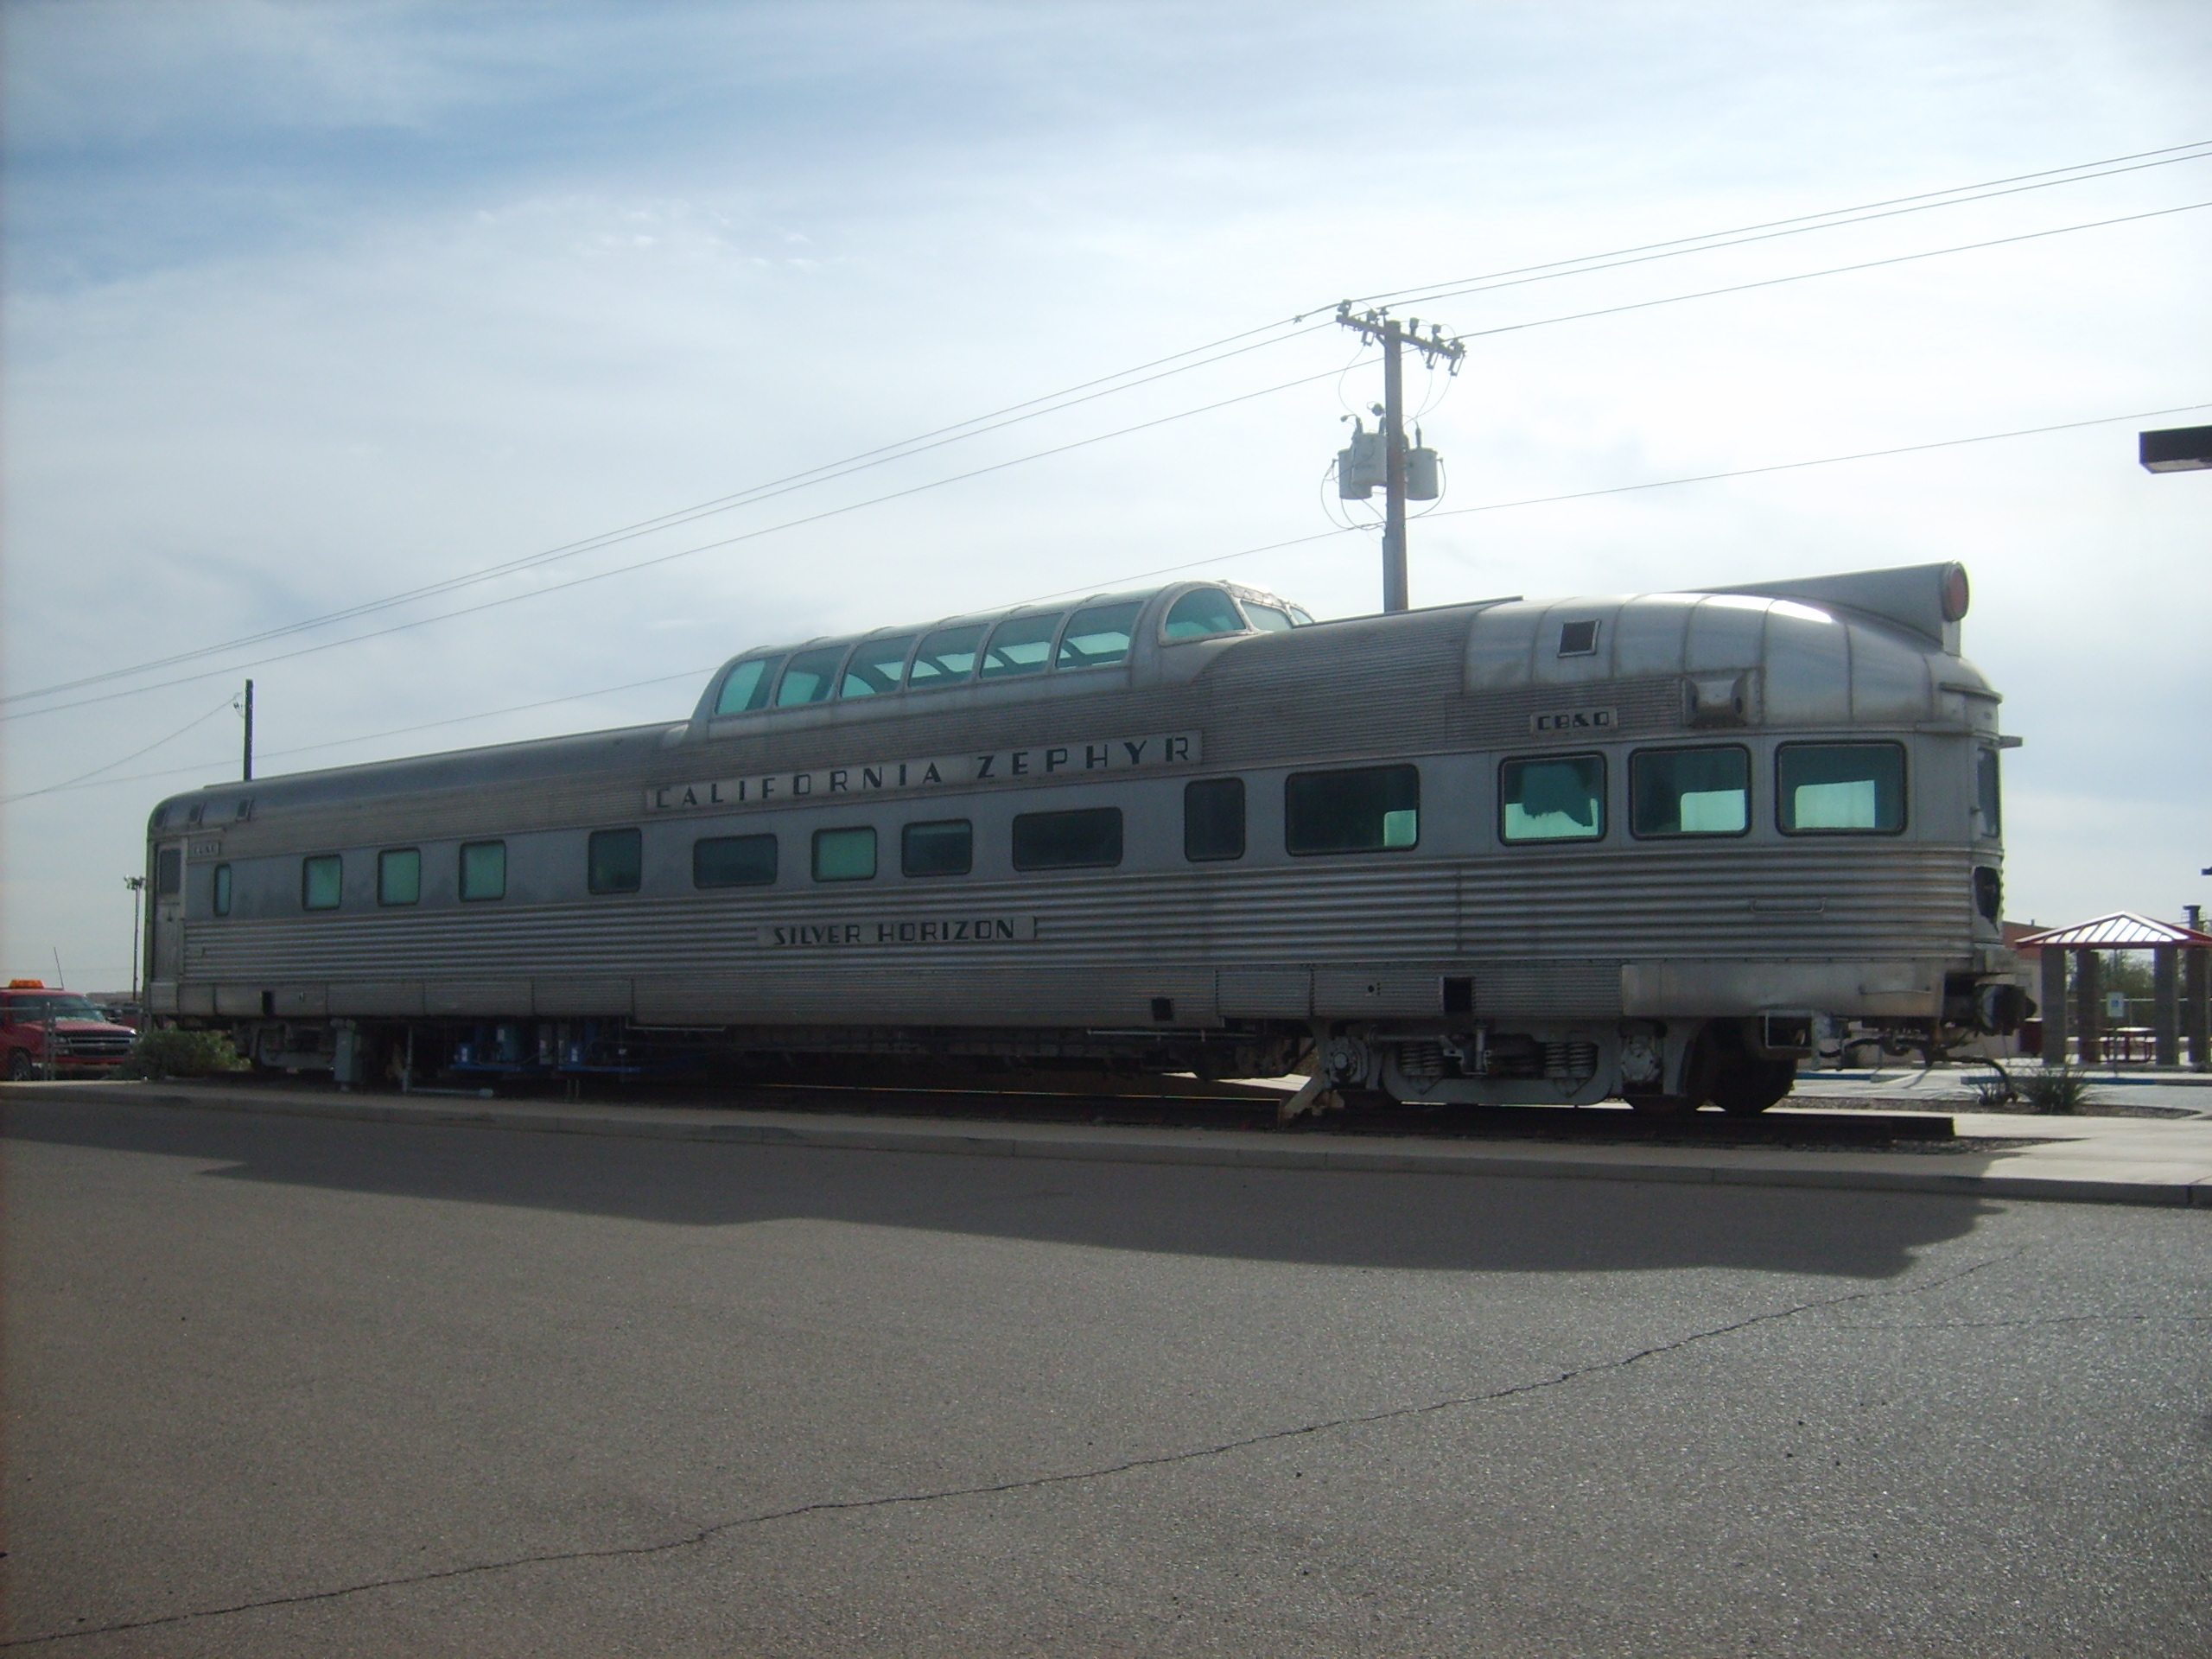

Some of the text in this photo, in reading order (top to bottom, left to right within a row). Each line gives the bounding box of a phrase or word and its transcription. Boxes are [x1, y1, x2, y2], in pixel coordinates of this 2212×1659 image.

[656, 736, 1189, 809] CALIFORNIA ZEPHYR
[773, 919, 1014, 945] SILVER HORIZON
